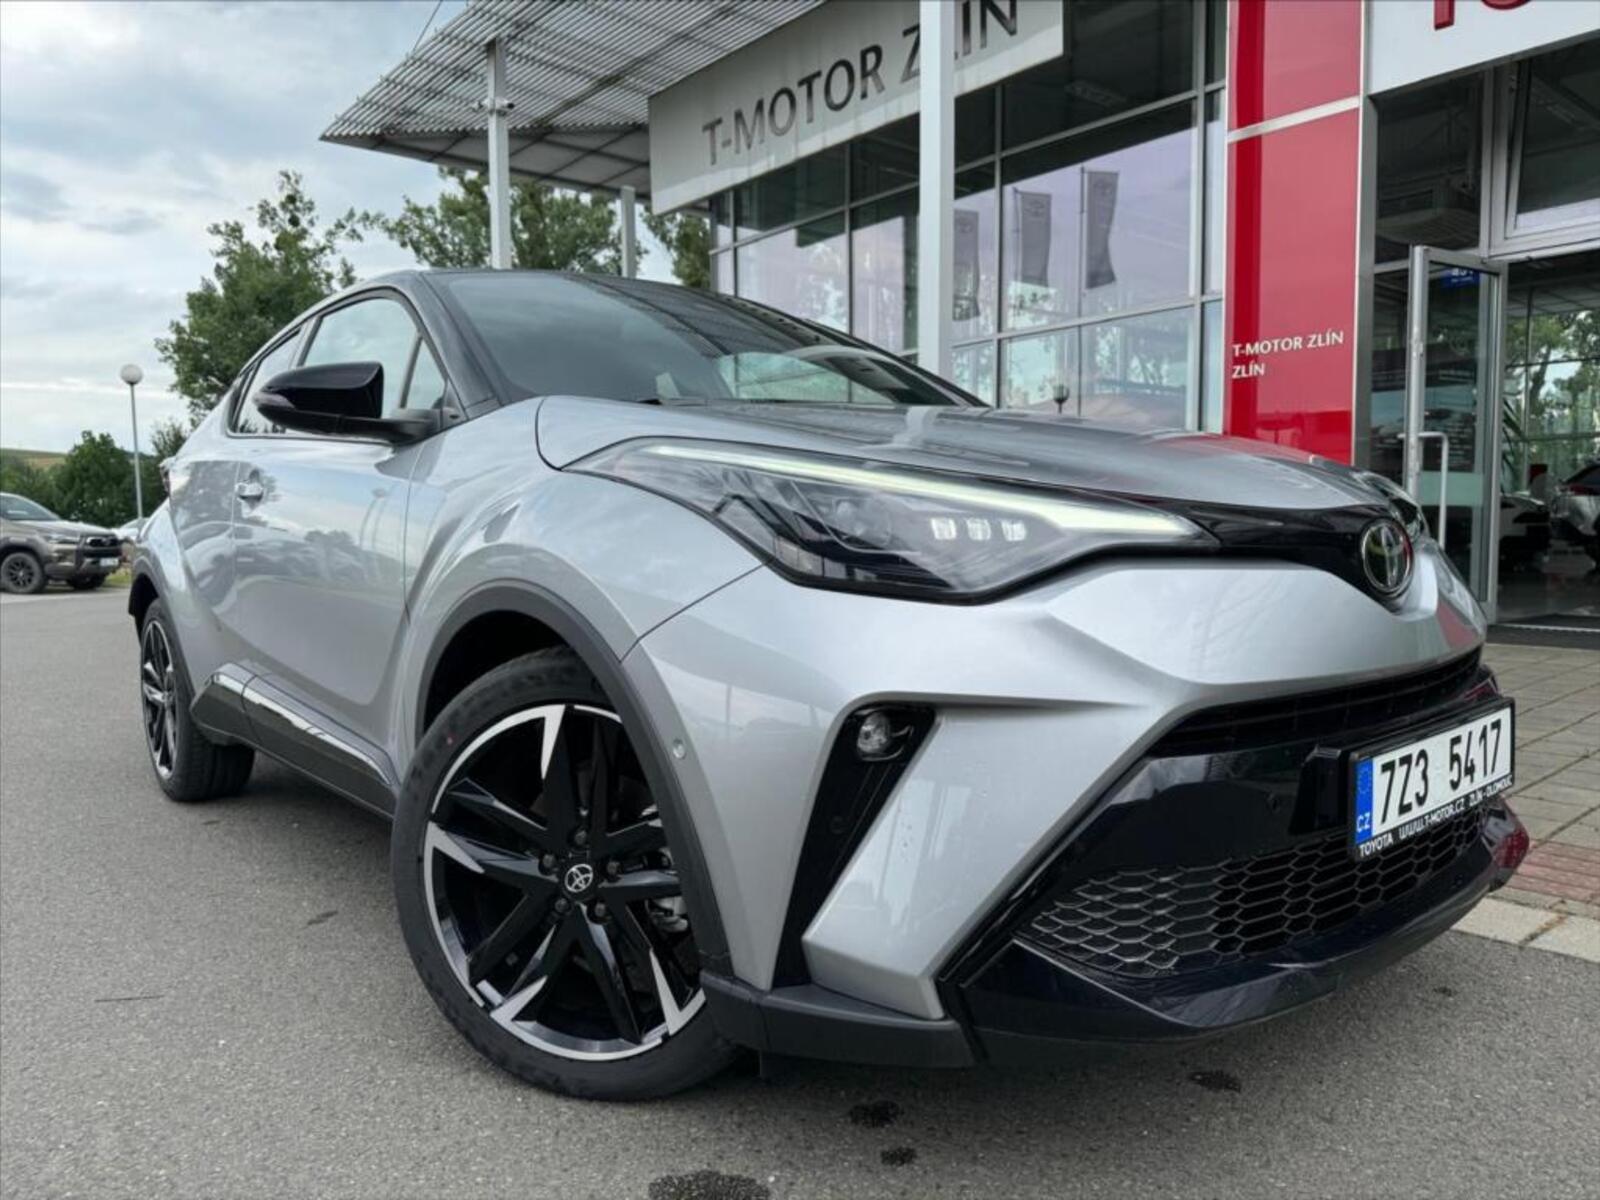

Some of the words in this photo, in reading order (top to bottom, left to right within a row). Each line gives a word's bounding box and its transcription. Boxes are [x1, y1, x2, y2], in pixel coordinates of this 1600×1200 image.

[701, 43, 886, 166] T-MOTOR
[1232, 336, 1303, 358] T-MOTOR
[1306, 327, 1344, 349] ZLÍN
[1231, 360, 1266, 380] ZLÍN
[1356, 811, 1371, 833] CZ
[1380, 748, 1429, 825] 7Z3
[1449, 718, 1502, 791] 5417
[1359, 832, 1394, 858] TOYOTA
